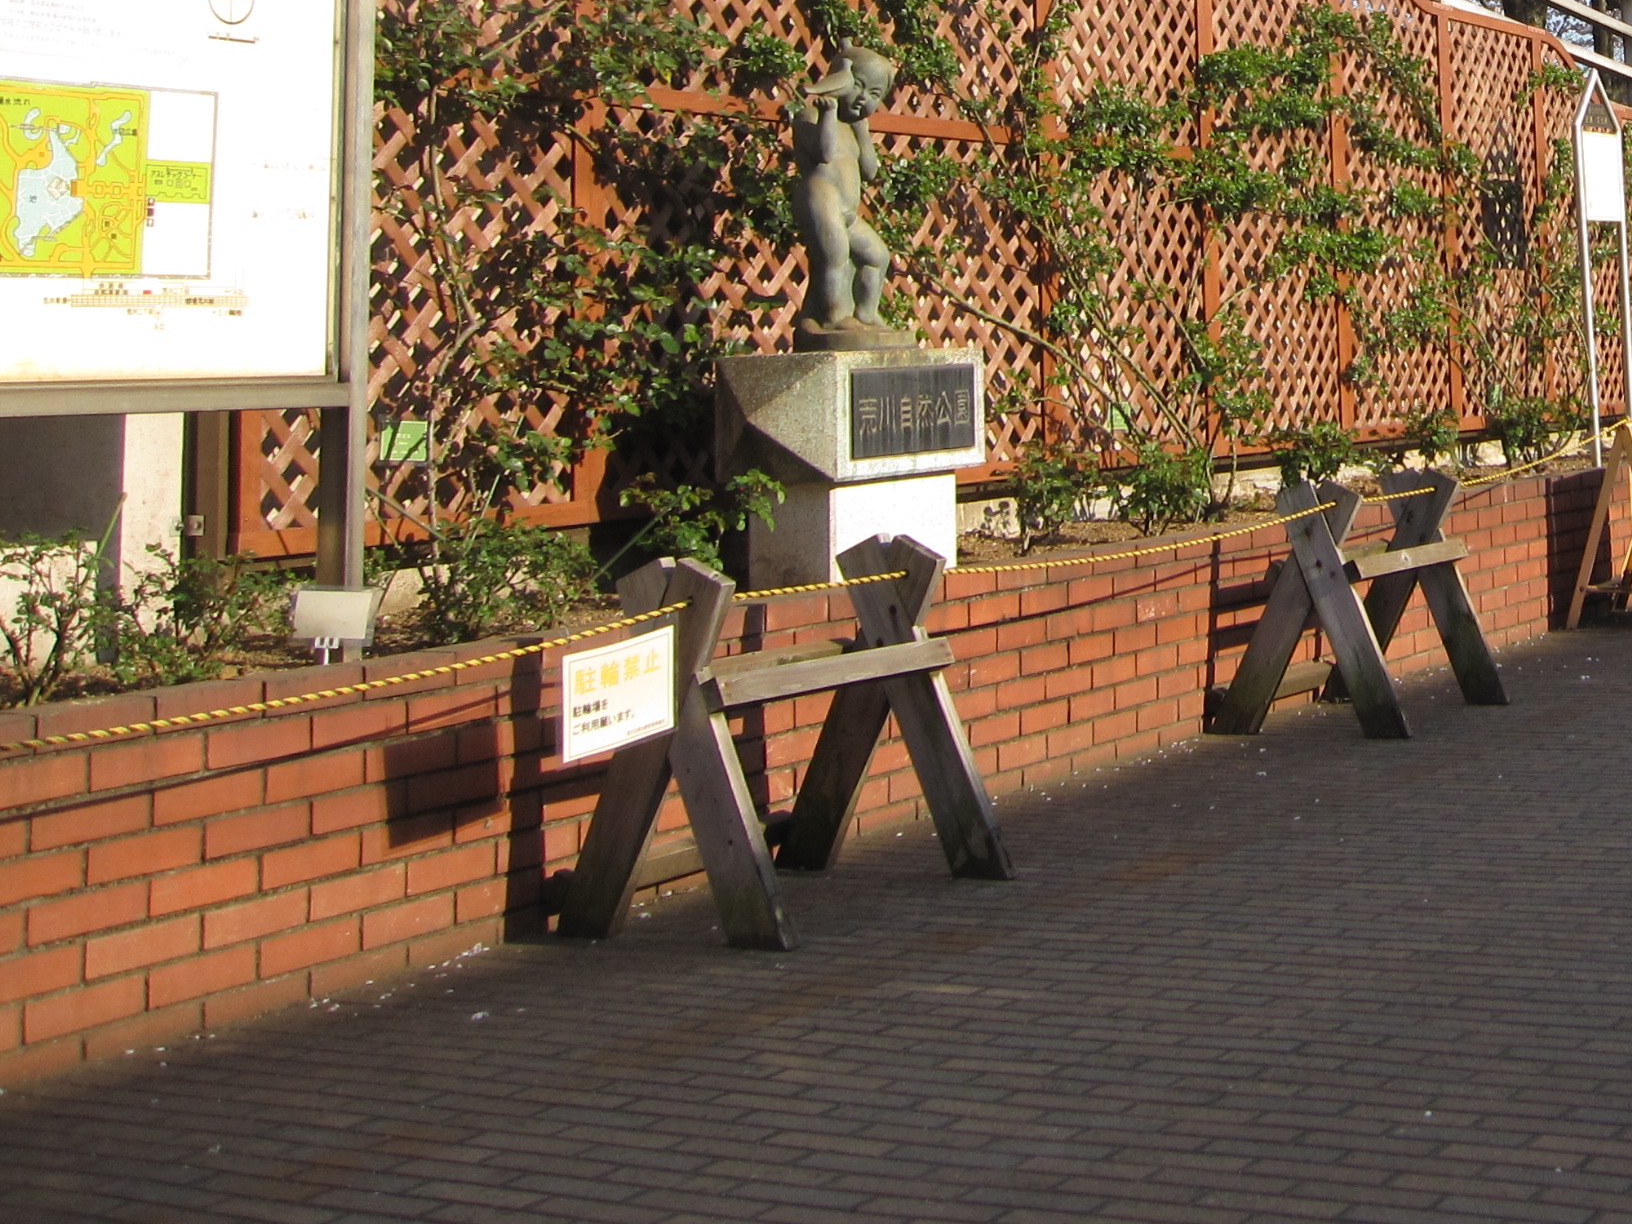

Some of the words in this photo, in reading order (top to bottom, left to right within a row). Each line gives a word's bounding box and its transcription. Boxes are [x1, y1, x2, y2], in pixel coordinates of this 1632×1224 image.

[858, 388, 971, 436] 荒川自然公園
[573, 647, 661, 695] 駐輪禁止
